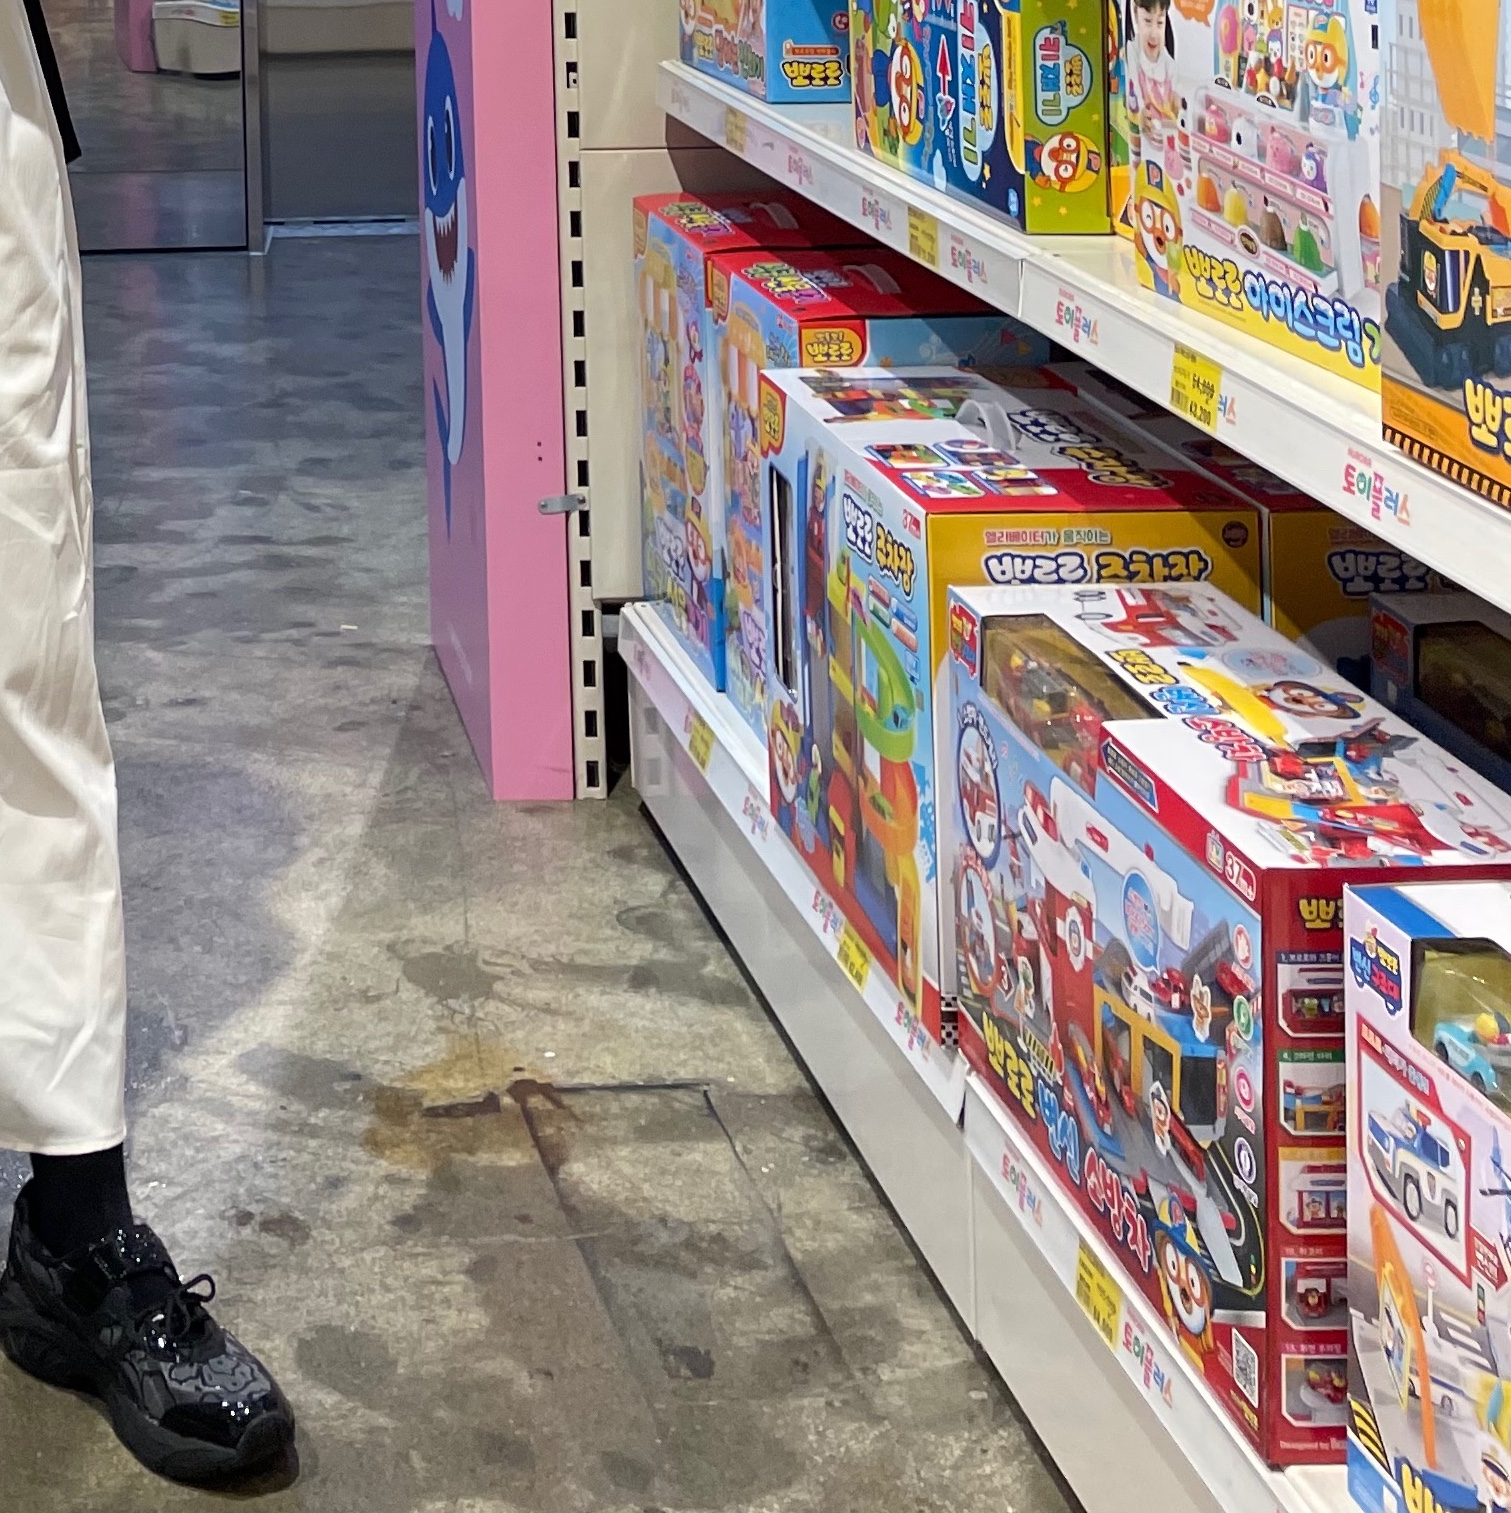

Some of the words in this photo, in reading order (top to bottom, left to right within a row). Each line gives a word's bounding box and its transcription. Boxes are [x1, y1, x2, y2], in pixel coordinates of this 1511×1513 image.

[783, 60, 843, 87] 뽀로로
[960, 0, 979, 166] 키재기
[1039, 37, 1063, 116] 키재기
[951, 246, 988, 285] 토이플러스
[1055, 297, 1099, 346] 토이플러스
[1184, 245, 1243, 312] 뽀로로
[1243, 269, 1365, 368] 아이스크림
[1343, 462, 1411, 527] 토이플러스
[843, 492, 874, 563] 뽀로로
[876, 522, 916, 599] 주차장
[985, 529, 1058, 545] 엘리베이터가
[1062, 529, 1112, 545] 움직이는
[1106, 649, 1180, 685] 뽀로로
[1183, 716, 1268, 763] 소방차
[1224, 850, 1256, 902] 37m+
[982, 1011, 1036, 1119] 뽀로로
[1038, 1080, 1080, 1186] 변신
[1085, 1146, 1151, 1273] 소방차
[1002, 1154, 1043, 1229] 토이플러스
[1122, 1321, 1172, 1409] 토이플러스
